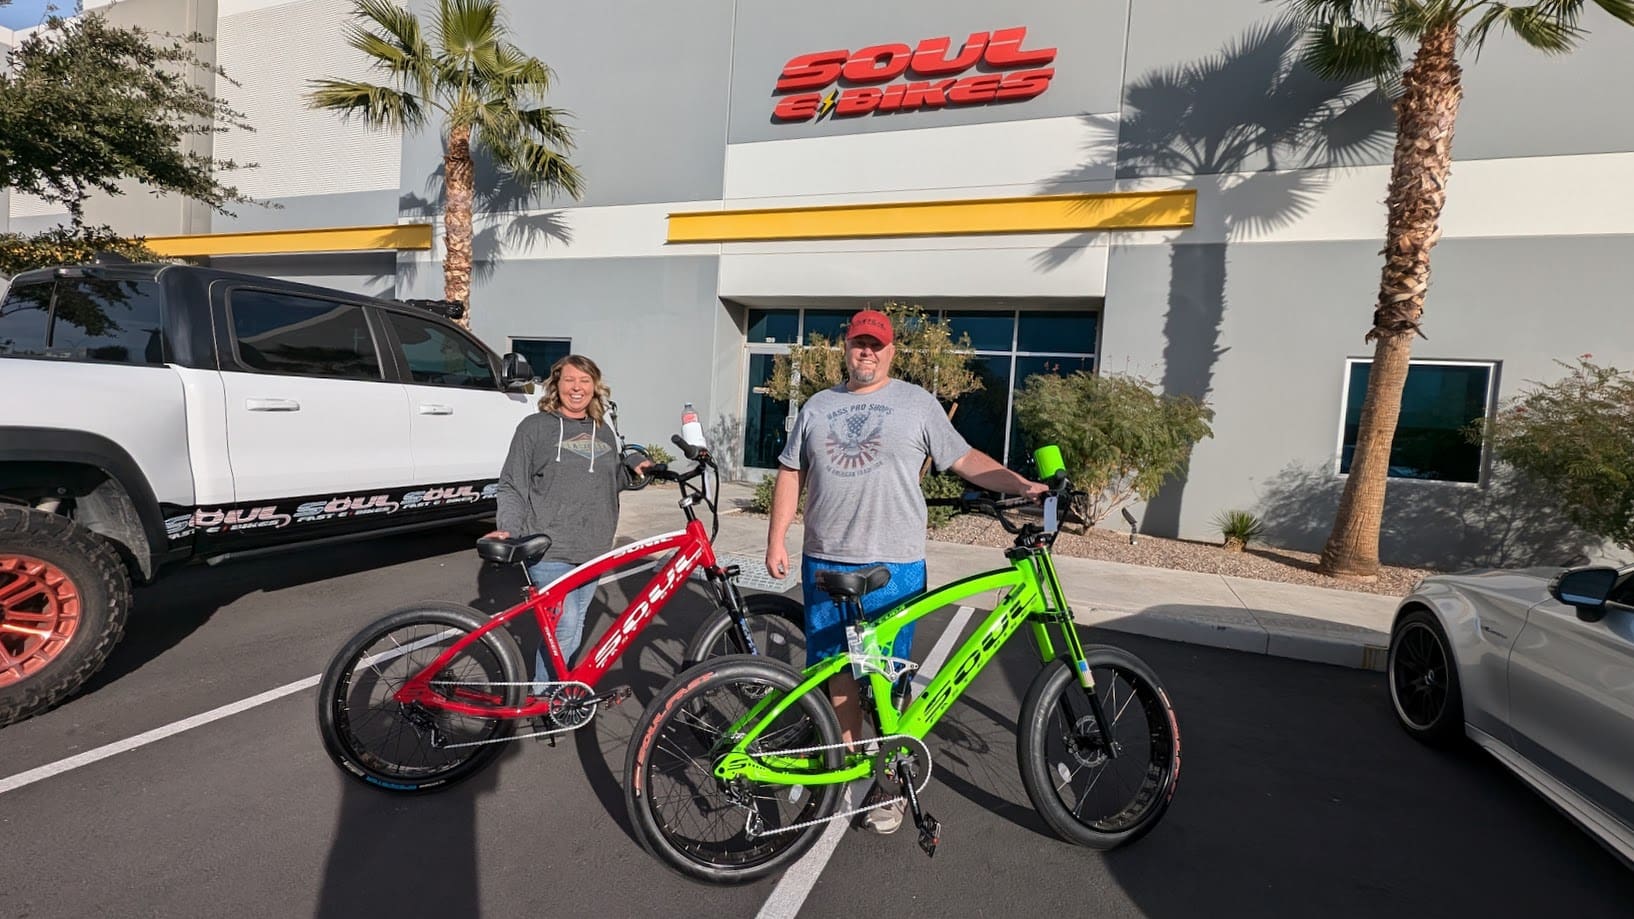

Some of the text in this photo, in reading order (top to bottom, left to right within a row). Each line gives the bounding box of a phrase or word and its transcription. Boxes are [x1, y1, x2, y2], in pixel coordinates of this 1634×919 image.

[774, 26, 1057, 92] SOUL
[293, 494, 400, 518] SOUL
[400, 485, 480, 505] SOUL
[165, 505, 292, 534] SOUL
[594, 547, 703, 668] SOUL
[924, 592, 1038, 723] SOUL
